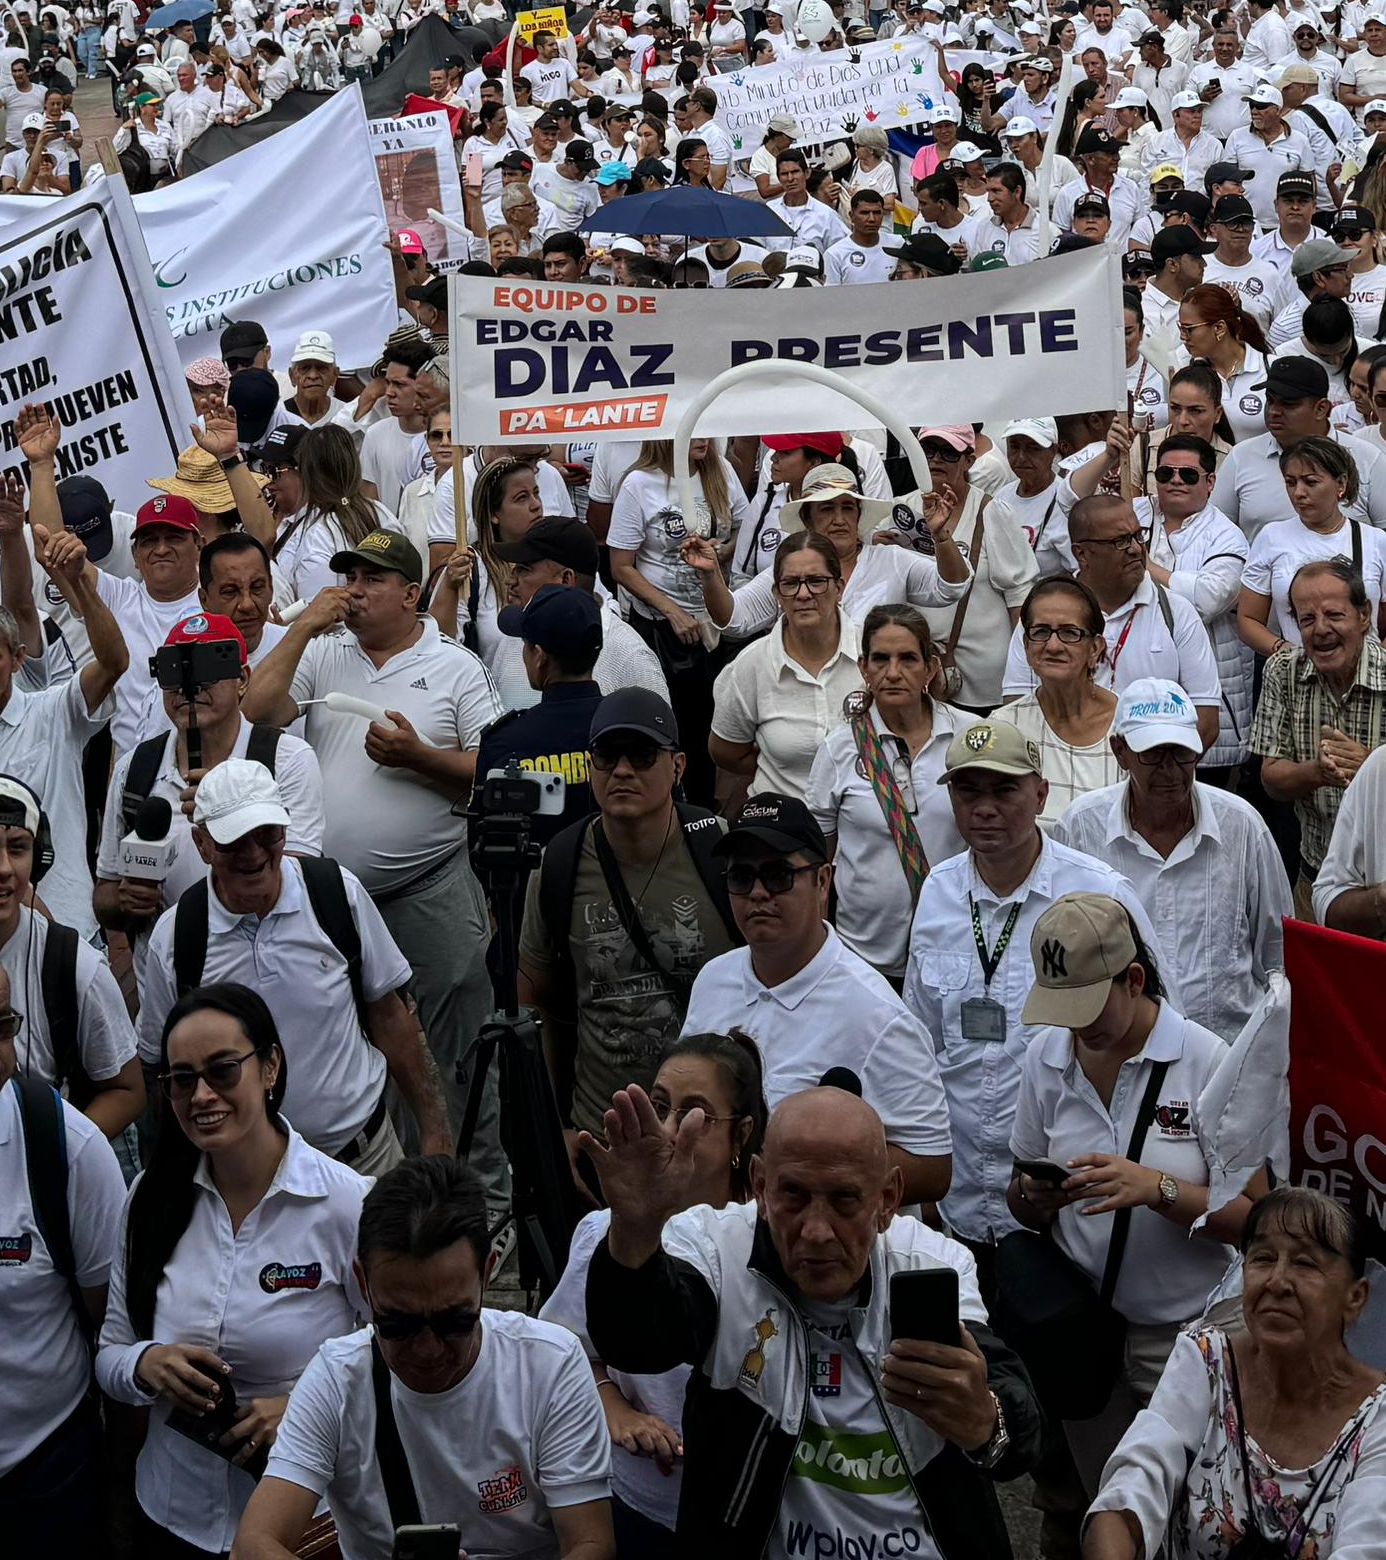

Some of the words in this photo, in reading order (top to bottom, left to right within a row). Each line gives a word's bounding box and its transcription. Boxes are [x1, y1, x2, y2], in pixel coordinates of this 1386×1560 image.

[521, 23, 537, 32] LOS
[746, 76, 800, 103] Minuto
[806, 72, 825, 90] de
[829, 63, 862, 85] Dios
[868, 54, 902, 76] una
[814, 88, 858, 110] unida
[862, 80, 887, 104] por
[893, 76, 909, 95] la
[369, 116, 437, 136] ERENLO
[382, 137, 405, 151] YA
[181, 253, 363, 320] INSTITUCIONES
[493, 287, 608, 314] EQUIPO
[617, 293, 657, 315] DE
[476, 318, 613, 345] EDGAR
[493, 343, 676, 399] DIAZ
[730, 308, 1079, 370] PRESENTE
[520, 752, 590, 783] BOMB
[0, 1240, 19, 1250] VOZ
[288, 1268, 307, 1278] VOZ
[795, 1440, 907, 1480] olanta
[478, 1471, 523, 1500] TEAM
